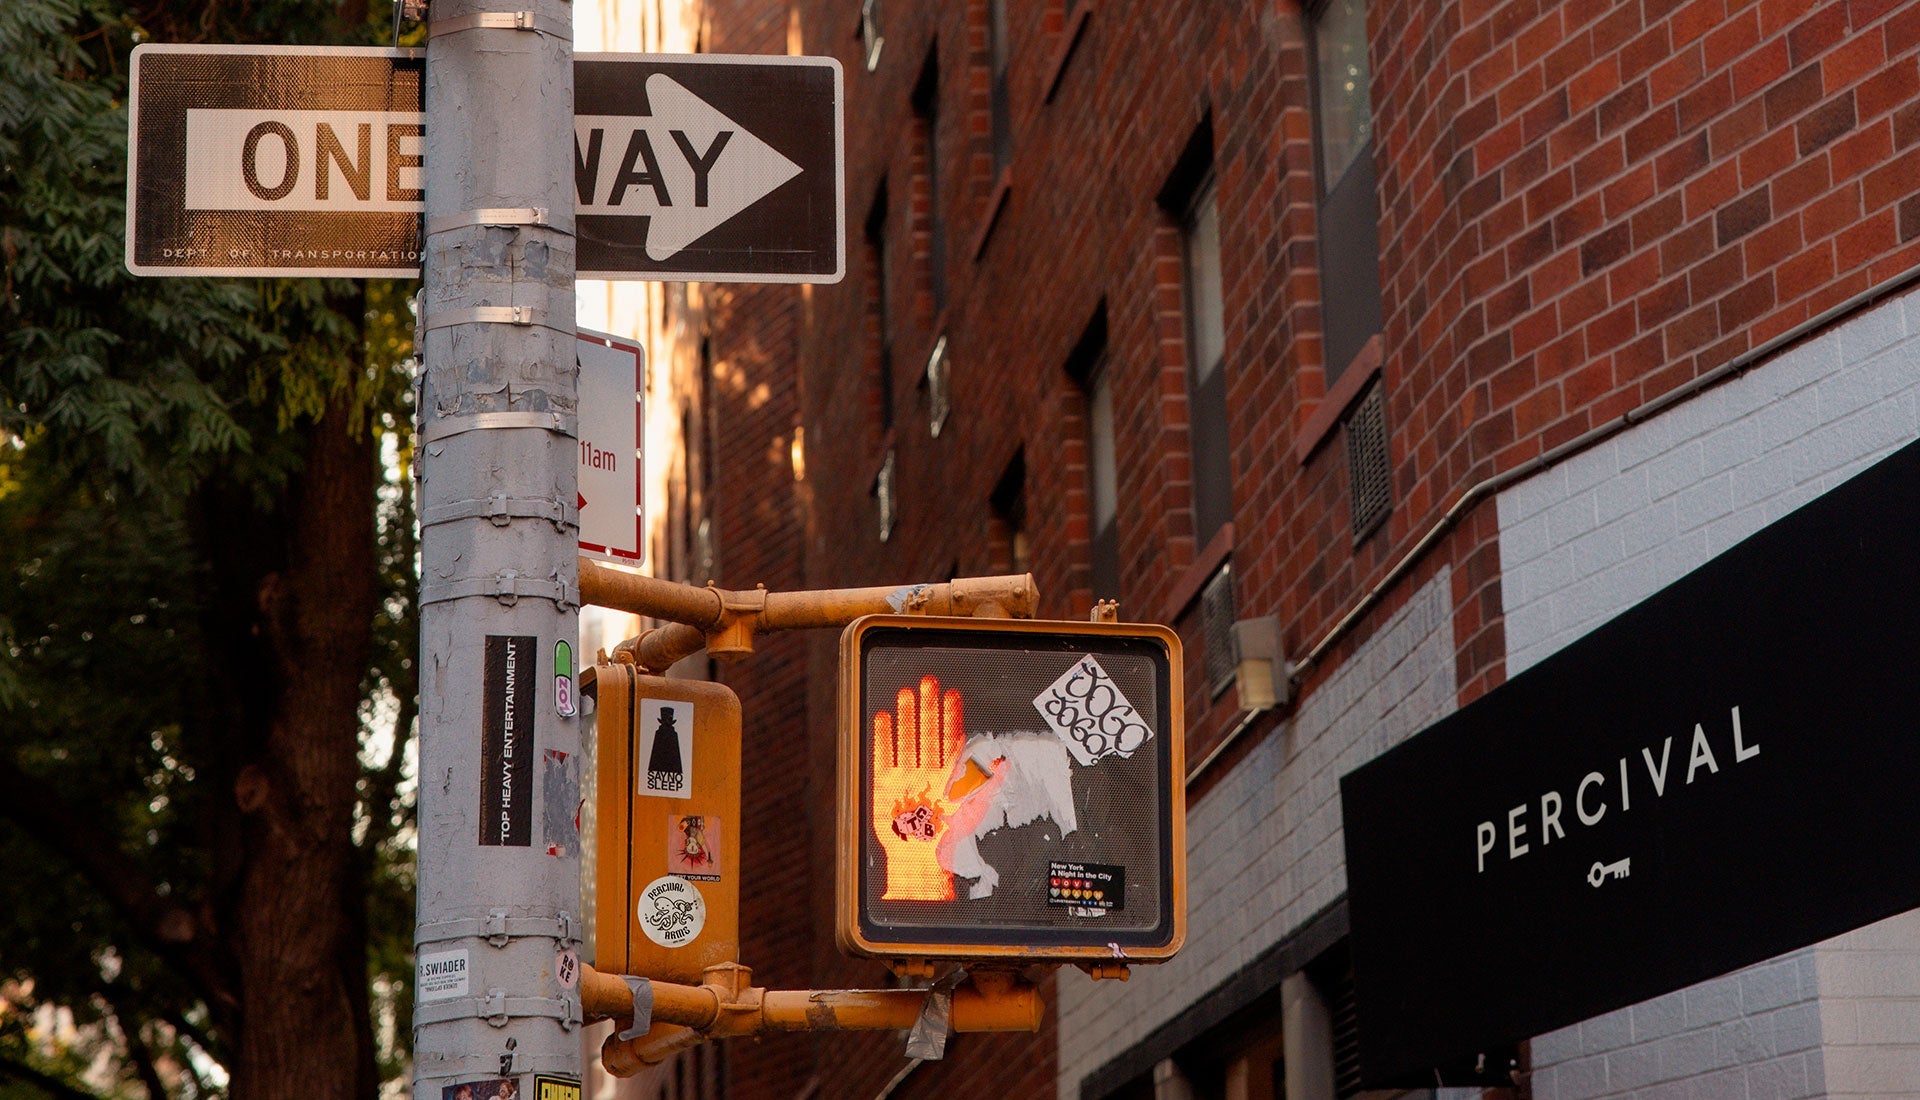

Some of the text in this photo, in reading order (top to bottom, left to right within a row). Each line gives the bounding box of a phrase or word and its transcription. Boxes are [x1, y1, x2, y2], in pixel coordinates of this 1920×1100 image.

[242, 120, 425, 201] ONE
[230, 249, 249, 259] OF
[272, 250, 417, 260] TRANSPORTATIO
[580, 440, 616, 472] 11am
[502, 761, 512, 808] HEAVY
[647, 780, 683, 791] SLEEP
[1477, 705, 1760, 873] PERCIVAL
[1051, 862, 1084, 871] New York
[1057, 870, 1076, 879] Night
[1098, 872, 1112, 881] City
[1051, 878, 1092, 889] LOVE
[647, 882, 685, 900] PERCIVAL
